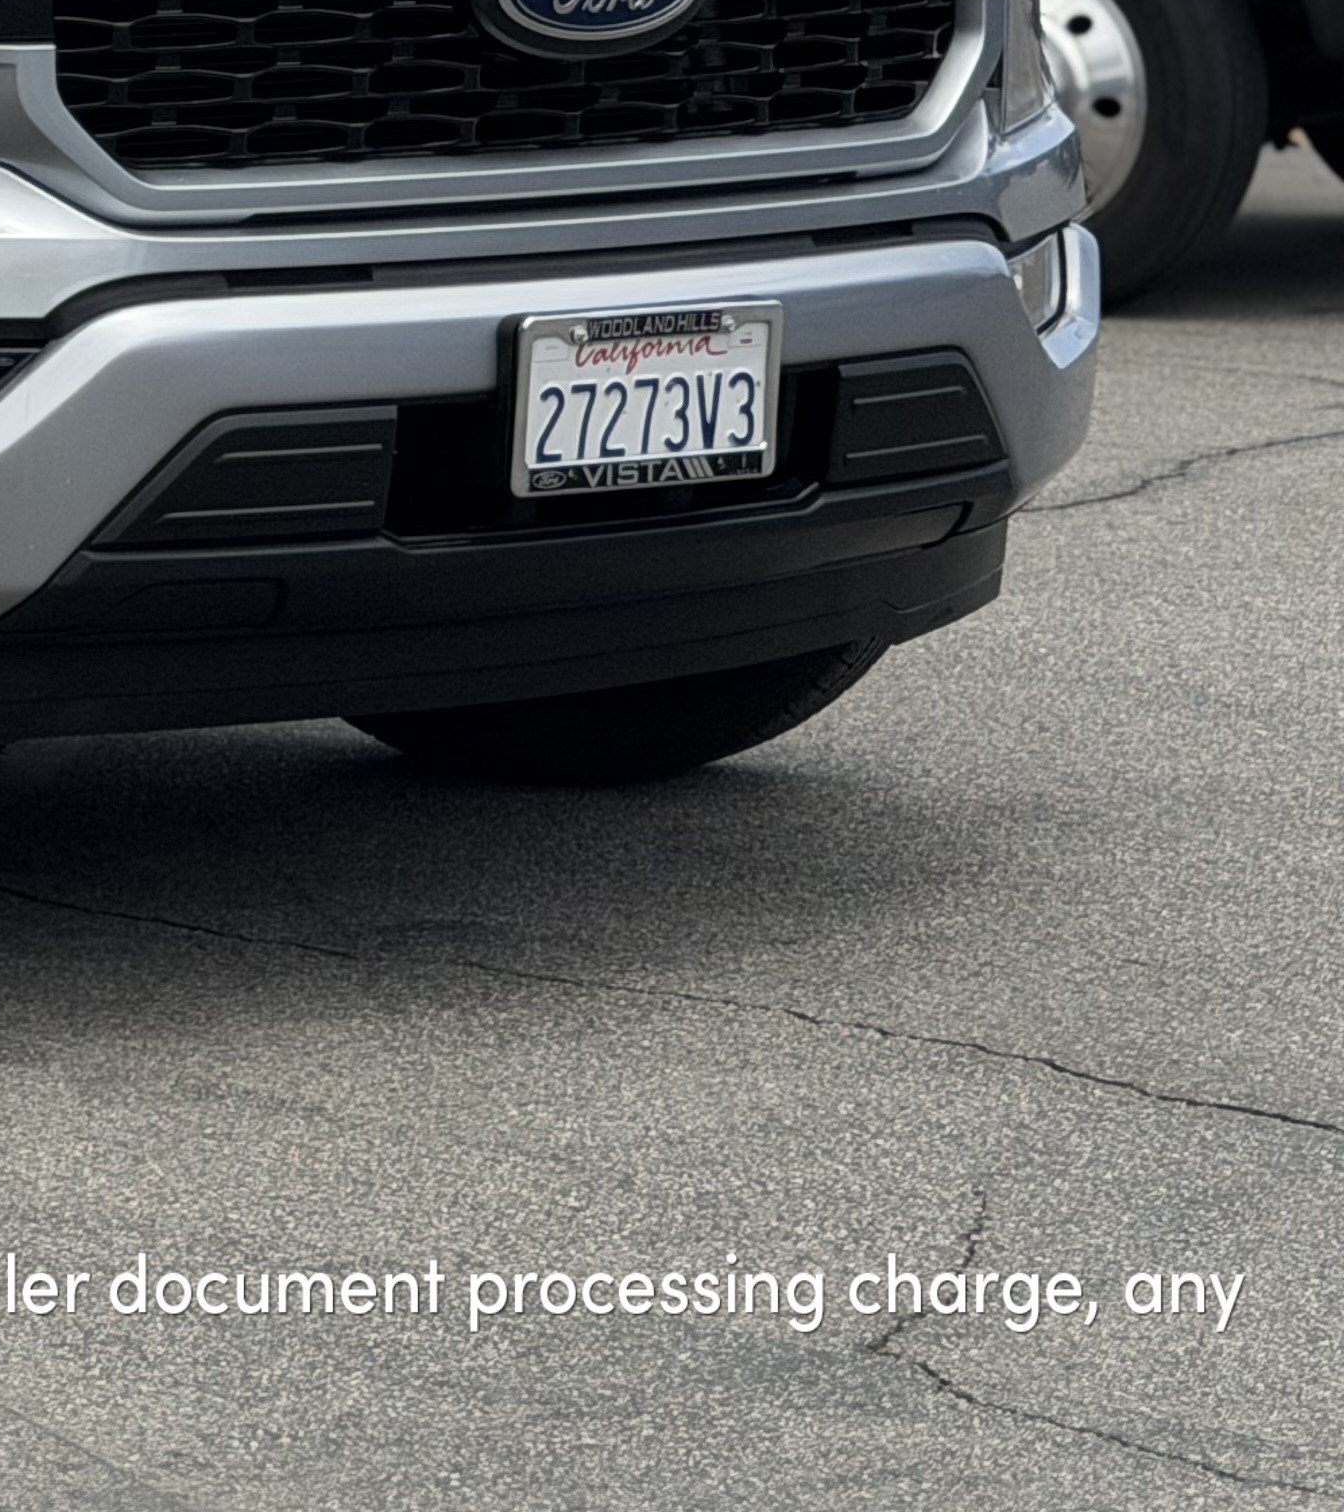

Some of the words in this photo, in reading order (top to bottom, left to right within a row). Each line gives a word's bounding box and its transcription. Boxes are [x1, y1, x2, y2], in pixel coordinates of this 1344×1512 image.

[588, 314, 676, 340] WOODLAND
[676, 310, 721, 334] HILLS
[574, 335, 729, 375] California
[535, 372, 755, 464] 27273V3
[582, 458, 691, 488] VISTA
